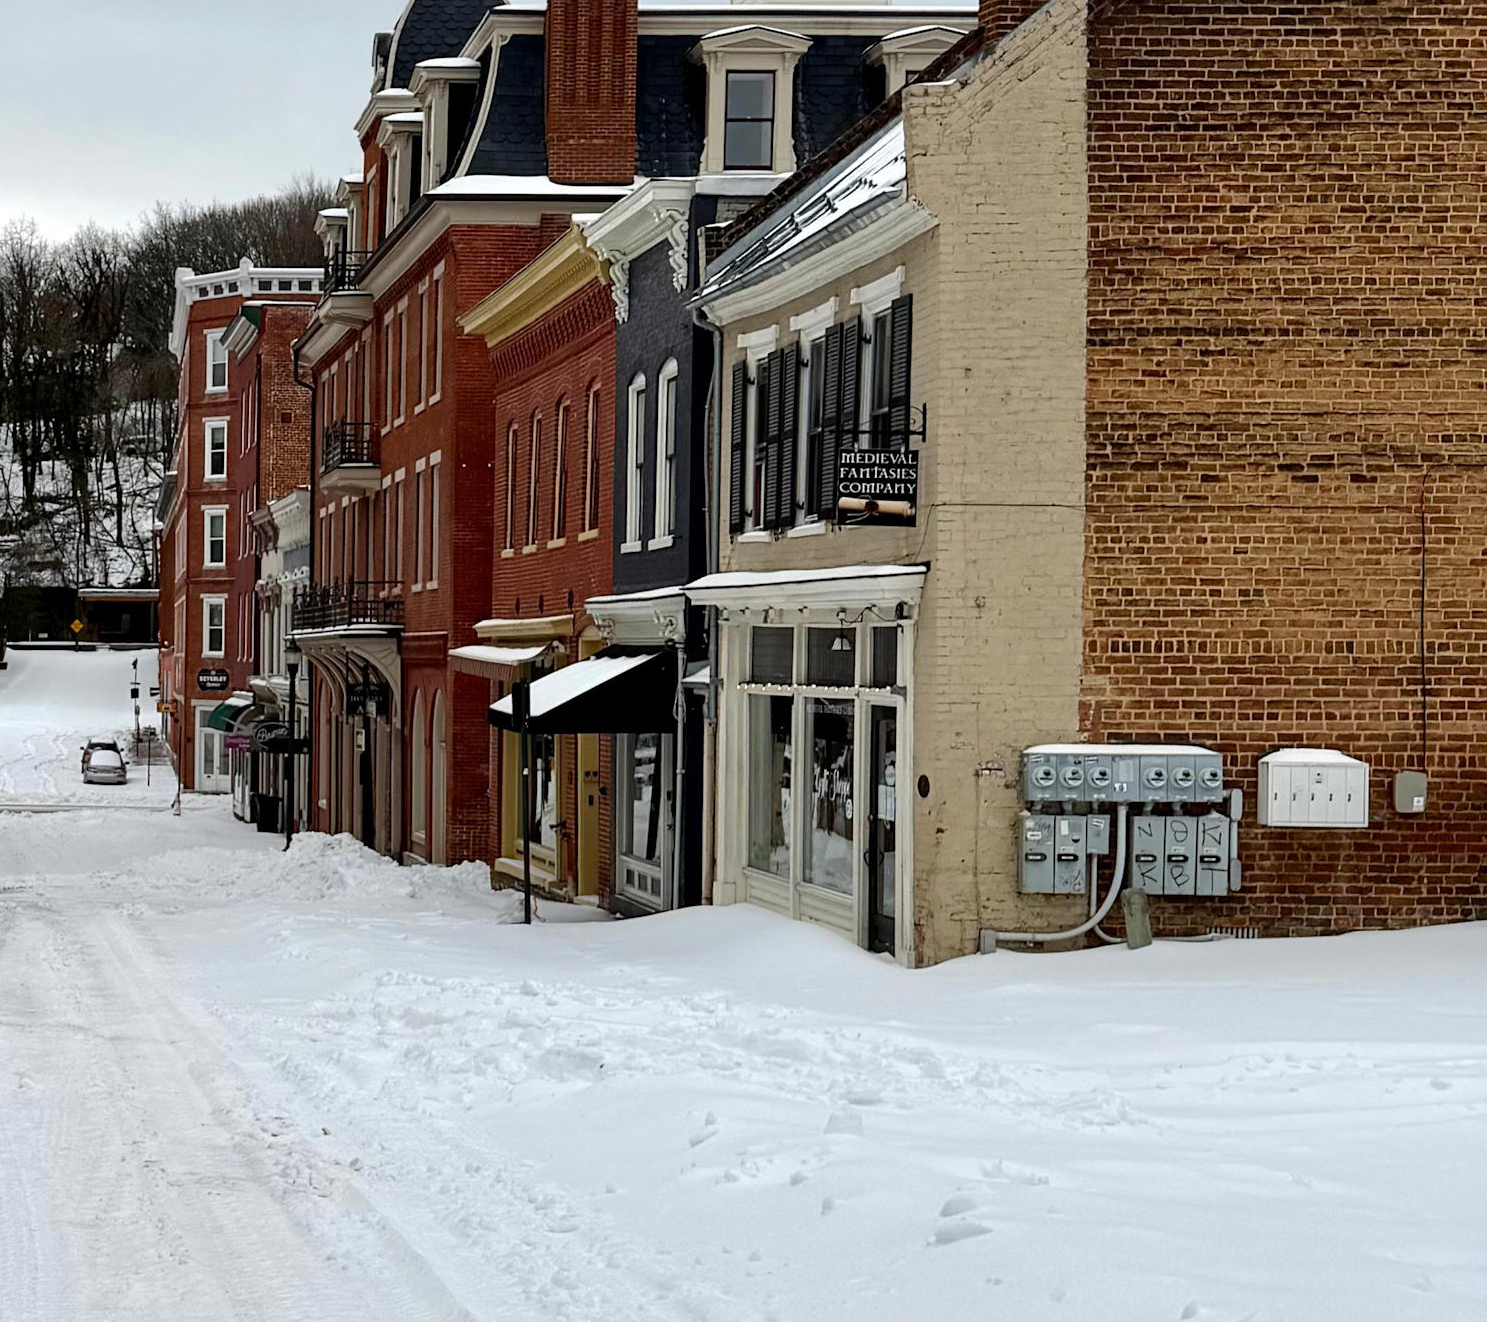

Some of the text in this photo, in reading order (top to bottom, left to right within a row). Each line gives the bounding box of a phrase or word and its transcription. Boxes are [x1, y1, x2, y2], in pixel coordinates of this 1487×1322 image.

[841, 452, 917, 465] MEDIEVAL
[839, 466, 917, 479] FANTASIES
[839, 482, 916, 494] COMPANY
